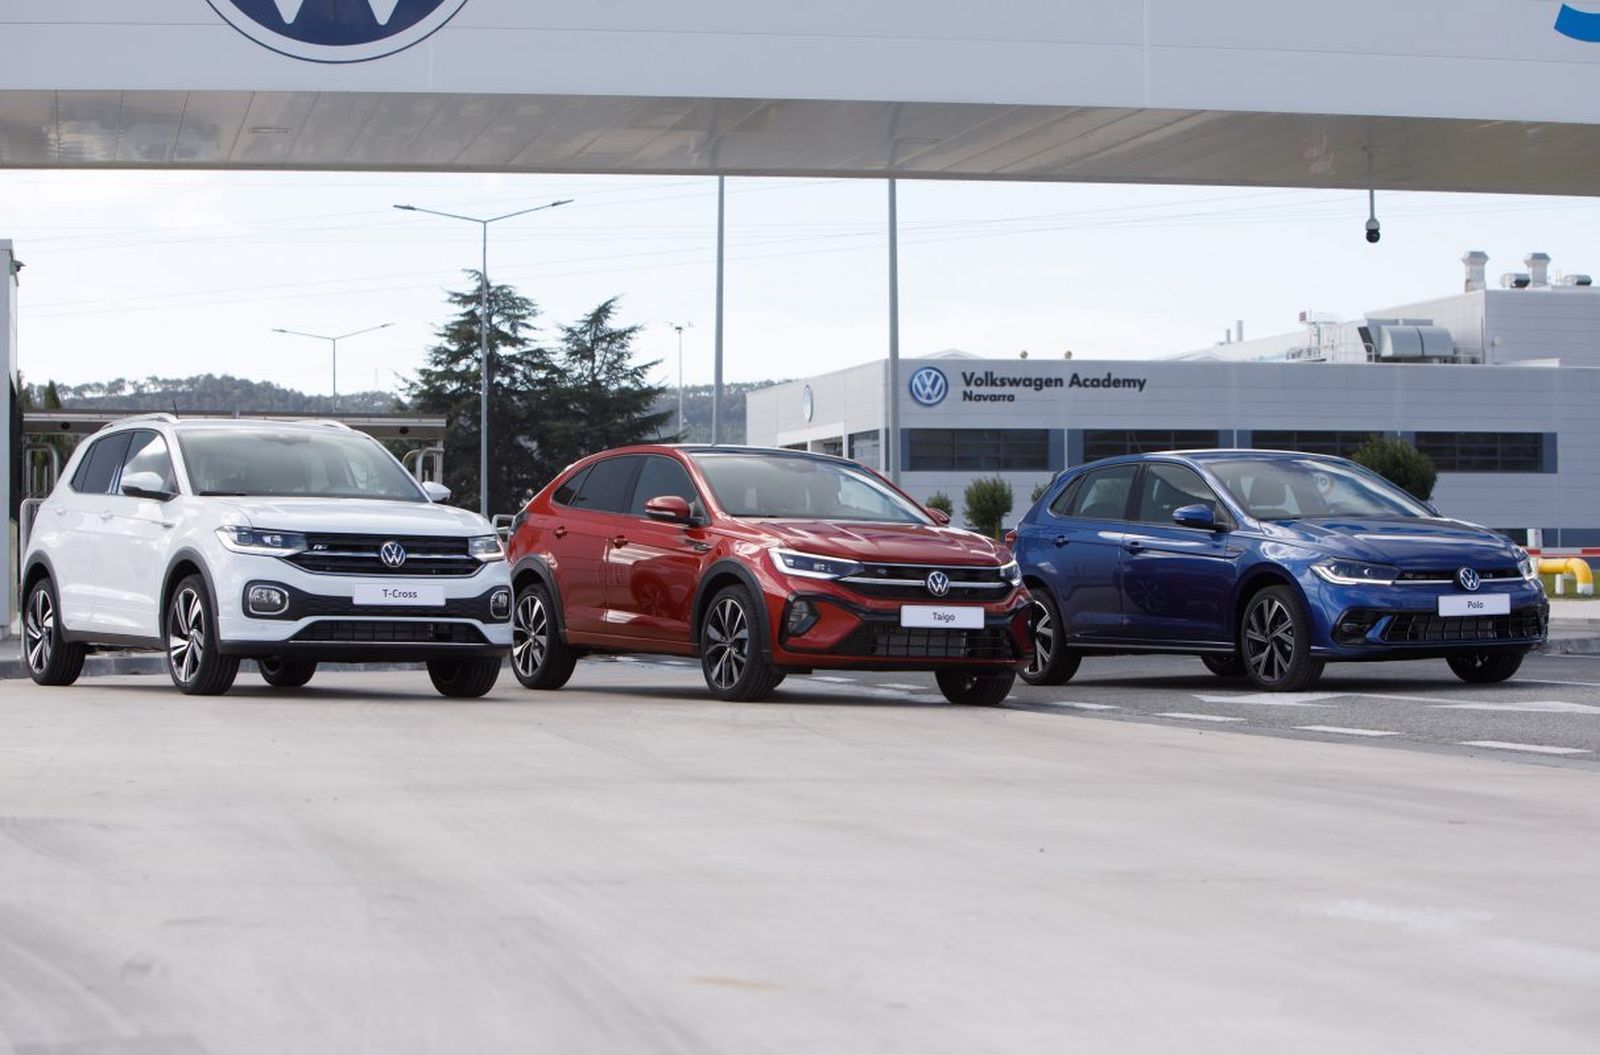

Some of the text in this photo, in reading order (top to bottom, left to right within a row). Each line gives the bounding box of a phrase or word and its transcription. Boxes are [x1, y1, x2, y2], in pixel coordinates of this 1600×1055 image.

[961, 372, 1147, 392] Volkswagen Academy
[962, 390, 1015, 402] Navarra
[382, 587, 418, 599] T-Cross
[1467, 600, 1484, 609] Polo
[932, 610, 956, 622] Taigo
